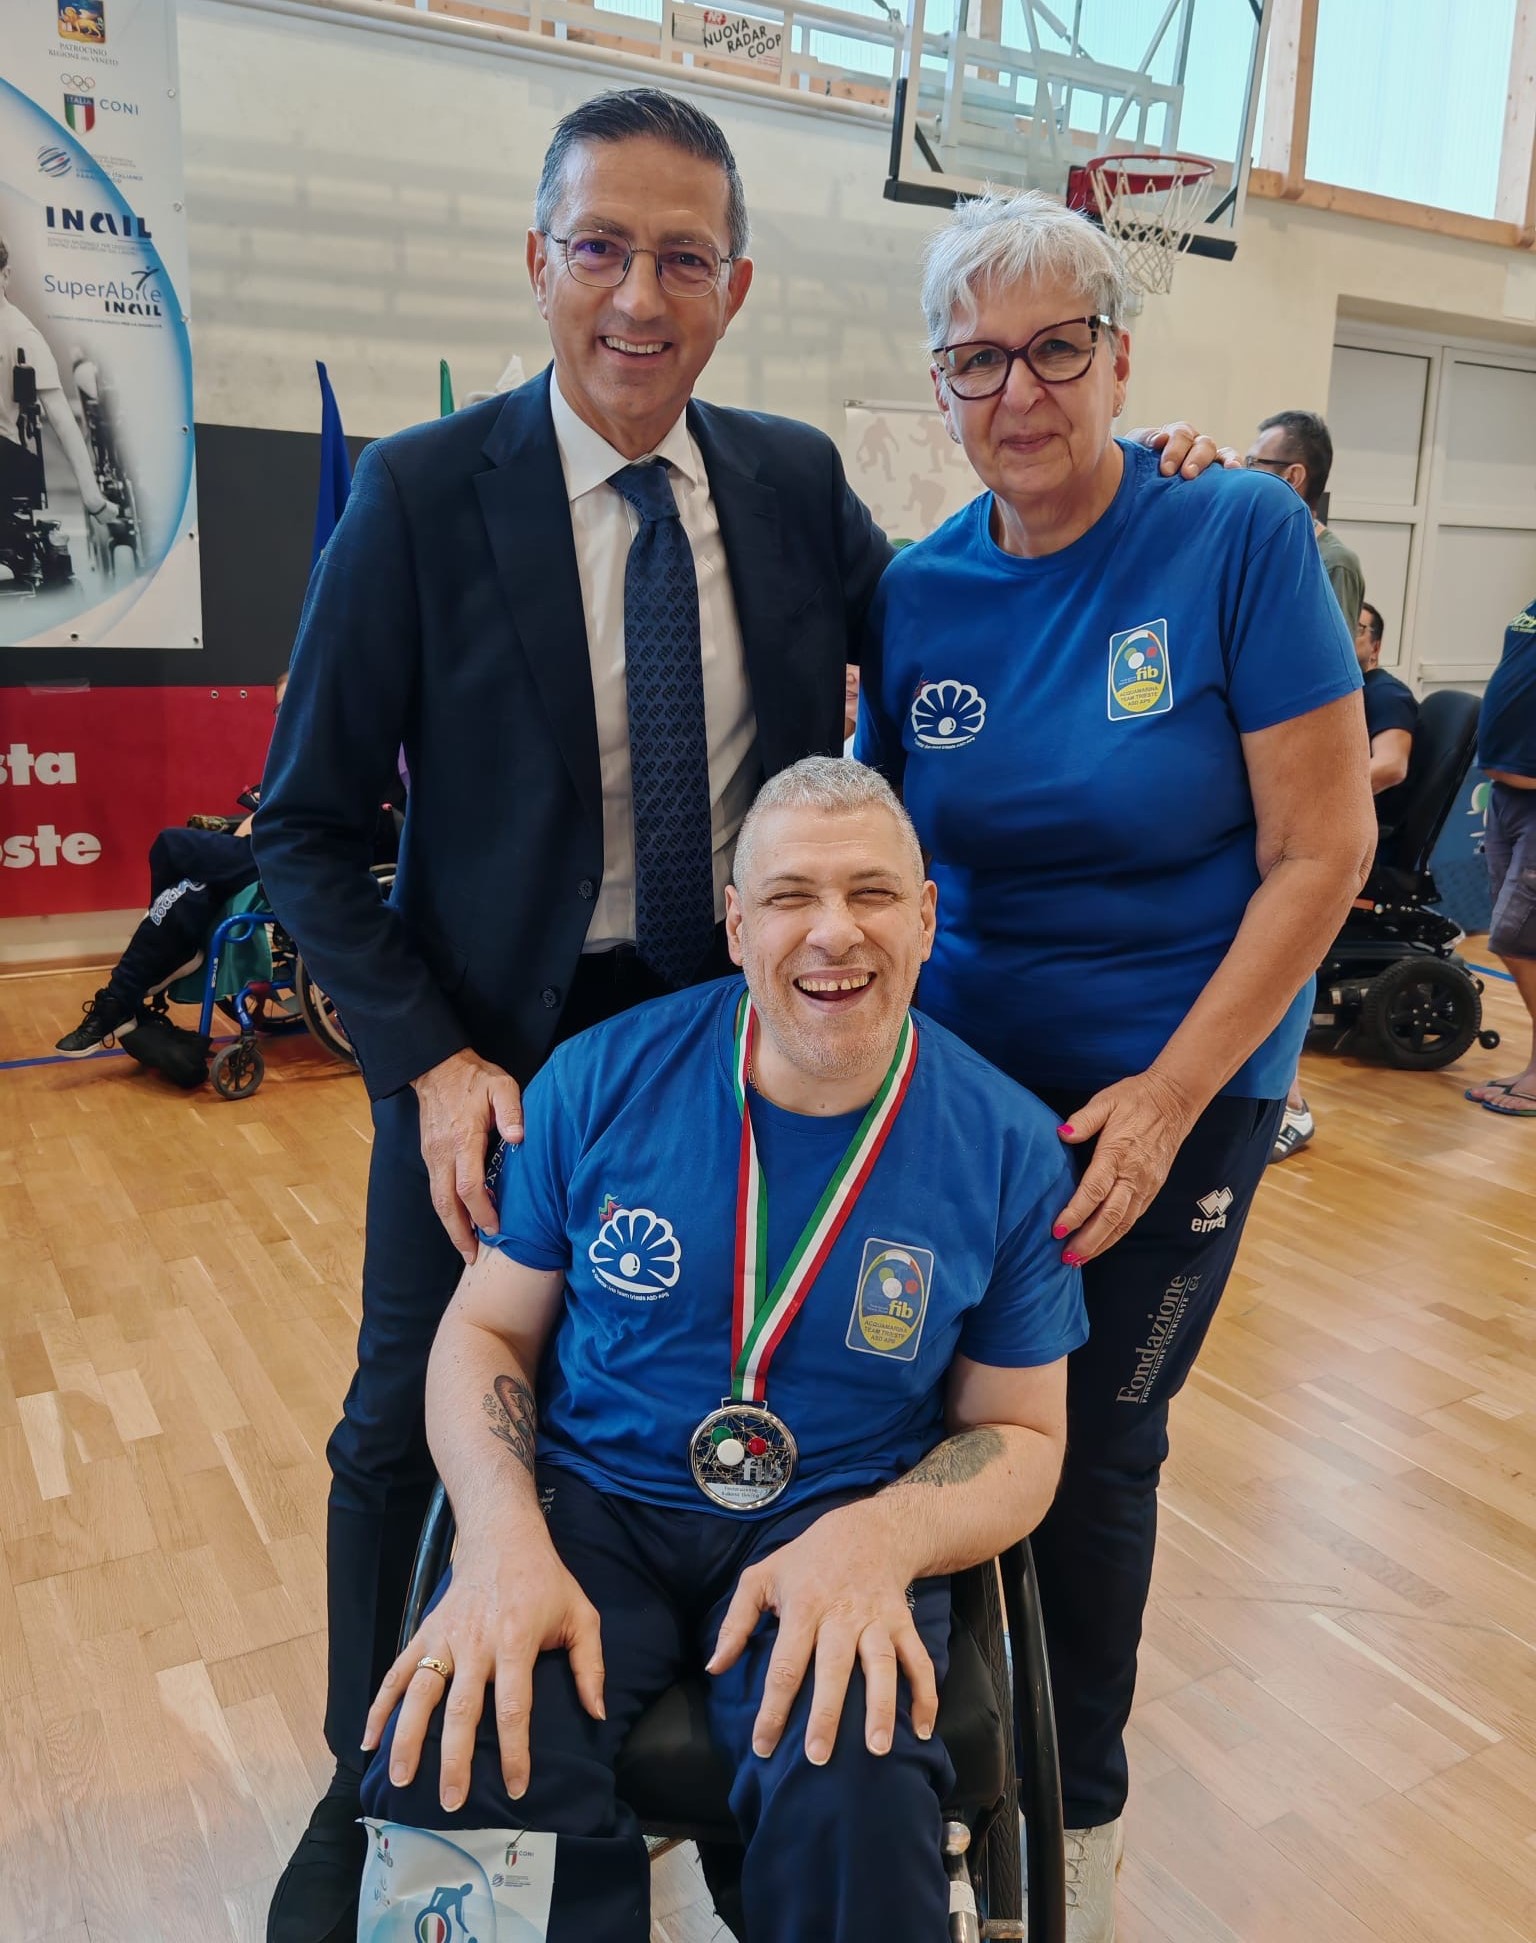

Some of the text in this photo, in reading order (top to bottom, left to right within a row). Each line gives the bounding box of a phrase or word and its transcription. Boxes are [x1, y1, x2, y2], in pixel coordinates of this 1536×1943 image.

[704, 18, 750, 48] NUOVA
[727, 25, 767, 54] RADAR
[747, 34, 782, 58] COOP
[99, 99, 139, 116] CONI
[46, 206, 152, 239] INAIL
[44, 273, 162, 304] SuperAbile
[105, 300, 162, 317] INAIL
[1136, 664, 1159, 681] fib
[0, 743, 77, 786] ta
[0, 824, 102, 869] ste
[888, 1299, 914, 1319] fib
[1116, 1275, 1188, 1404] Fondazione
